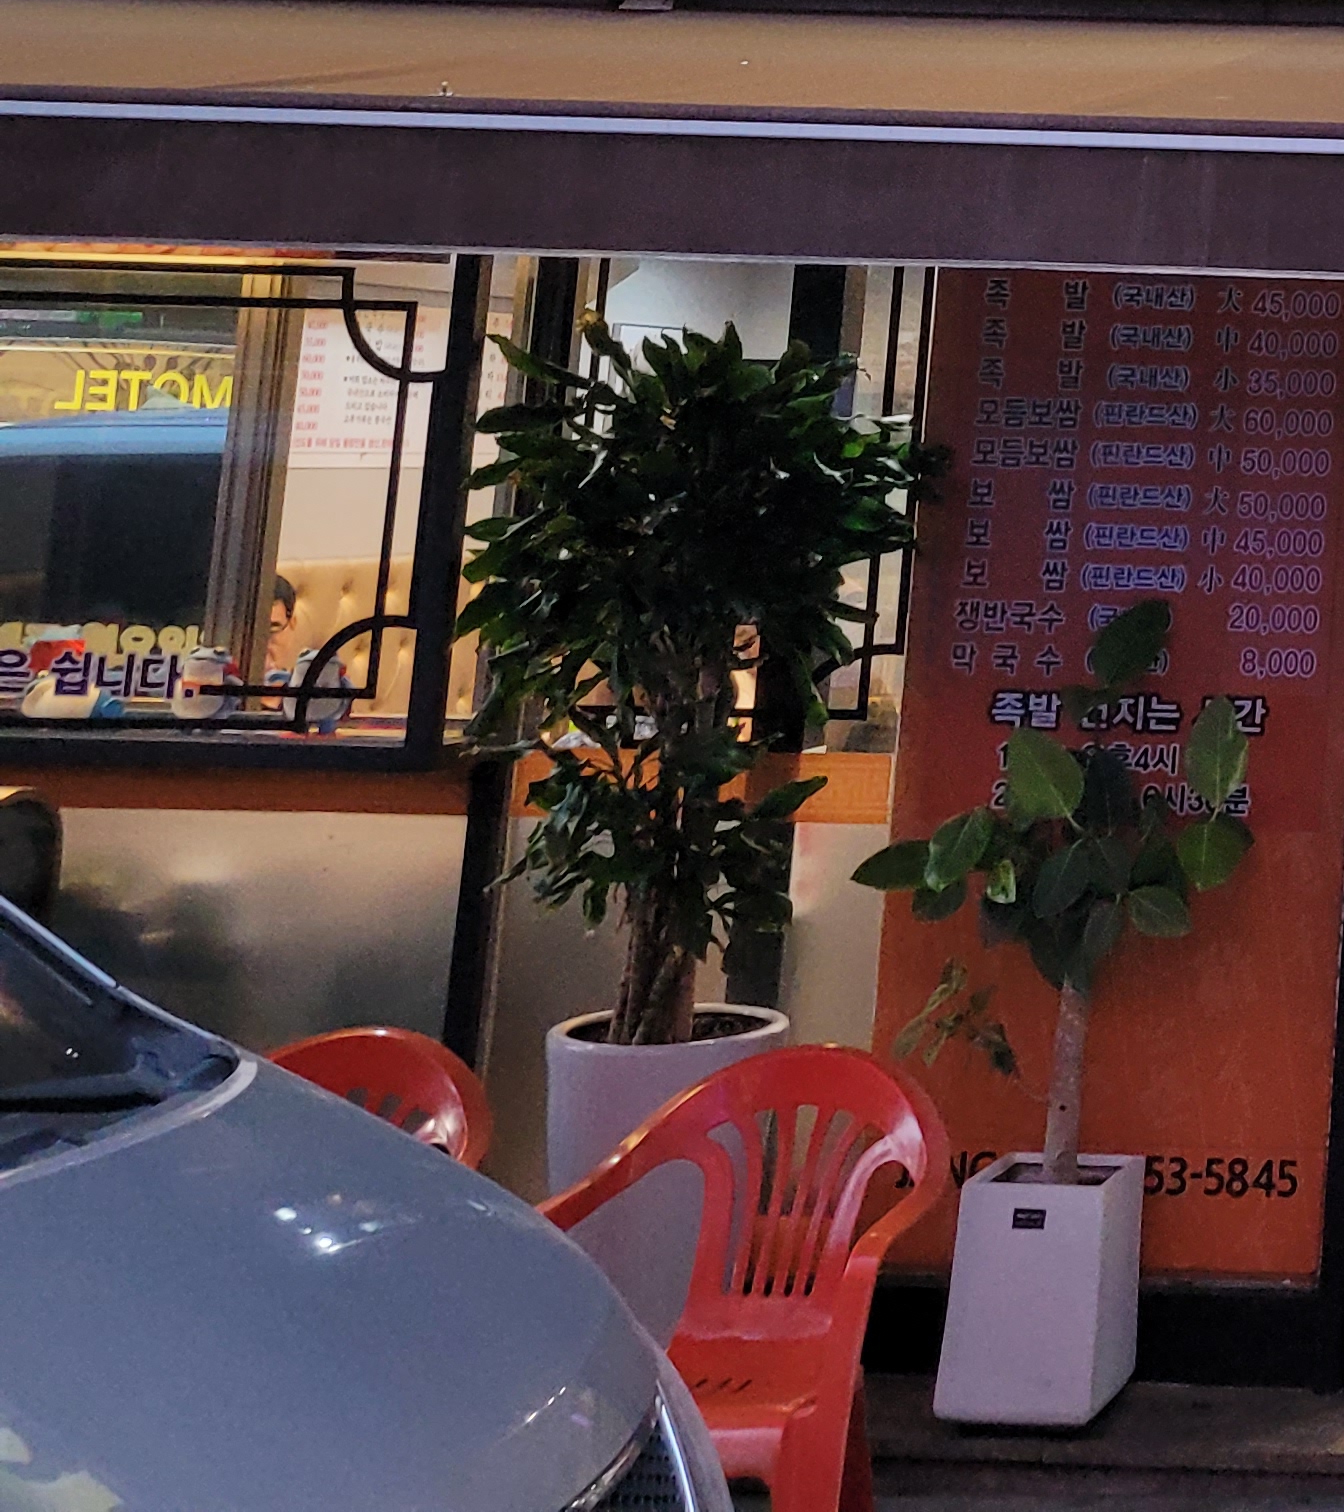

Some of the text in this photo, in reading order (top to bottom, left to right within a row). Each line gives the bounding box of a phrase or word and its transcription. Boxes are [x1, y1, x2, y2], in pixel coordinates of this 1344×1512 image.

[1114, 283, 1195, 310] (국내산)
[1253, 291, 1341, 321] 45,000
[1110, 324, 1193, 350] (국내산)
[1248, 330, 1338, 360] 40,000
[1107, 364, 1190, 391] (국내산)
[1247, 369, 1336, 399] 35,000
[975, 397, 1082, 429] 모듬보쌈
[1094, 402, 1198, 429] (핀란드산)
[1243, 407, 1333, 439] 60,000
[971, 438, 1078, 469] 모듬보쌈
[1090, 442, 1195, 469] (핀란드산)
[1241, 448, 1331, 479] 50,000
[1088, 484, 1192, 511] (핀란드산)
[1238, 492, 1326, 522] 50,000
[1084, 523, 1189, 550] (핀란드산)
[1233, 529, 1324, 559] 45,000
[1081, 563, 1186, 592] (핀란드산)
[1232, 565, 1322, 596] 40,000
[955, 600, 1065, 634] 쟁반국수
[1228, 603, 1320, 636] 20,000
[1240, 648, 1316, 679] 8,000
[990, 691, 1061, 728] 족발
